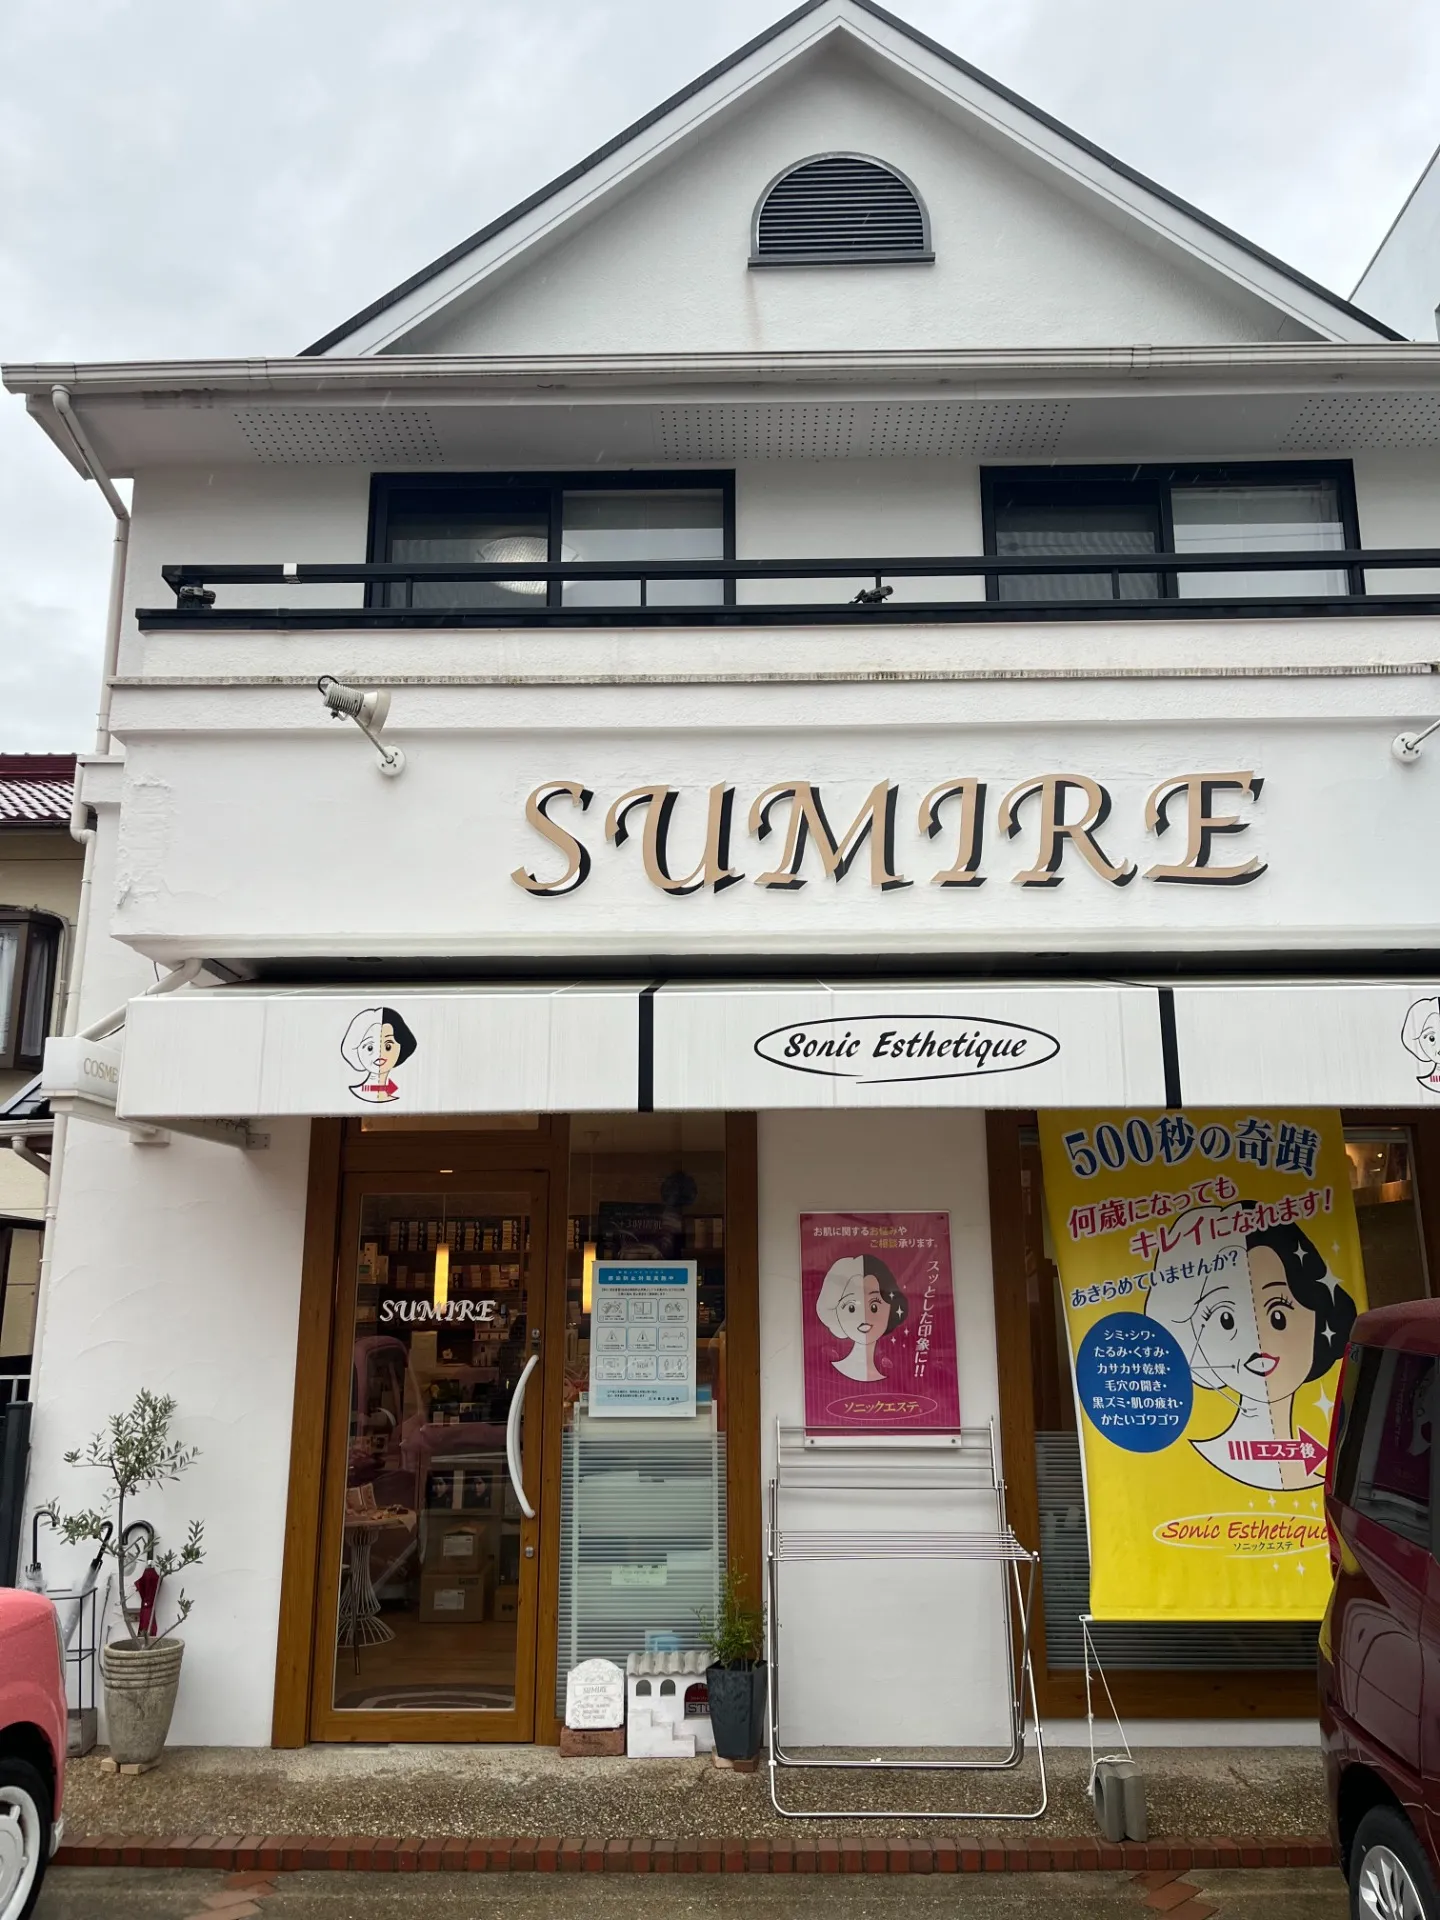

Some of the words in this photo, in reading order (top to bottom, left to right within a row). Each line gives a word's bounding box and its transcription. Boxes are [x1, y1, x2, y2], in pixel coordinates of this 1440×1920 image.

[511, 770, 1268, 896] SUMIRE
[784, 1031, 861, 1058] Sonic
[872, 1030, 1028, 1068] Esthetique
[1064, 1116, 1319, 1177] 500秒の奇蹟
[1069, 1177, 1236, 1238] 何歳になっても
[1132, 1189, 1332, 1258] キレイになれます!
[1071, 1250, 1239, 1307] あきらめていませんか?
[380, 1299, 496, 1321] SUMIRE
[914, 1260, 939, 1377] スッとした印象に!!
[1094, 1346, 1169, 1357] たるみ・くすみ・
[1101, 1414, 1179, 1425] かたいゴワゴワ
[1257, 1442, 1316, 1458] エステ後
[1162, 1516, 1220, 1539] Sonic
[1227, 1516, 1328, 1547] Esthetique
[1233, 1541, 1293, 1551] ソニックエステ
